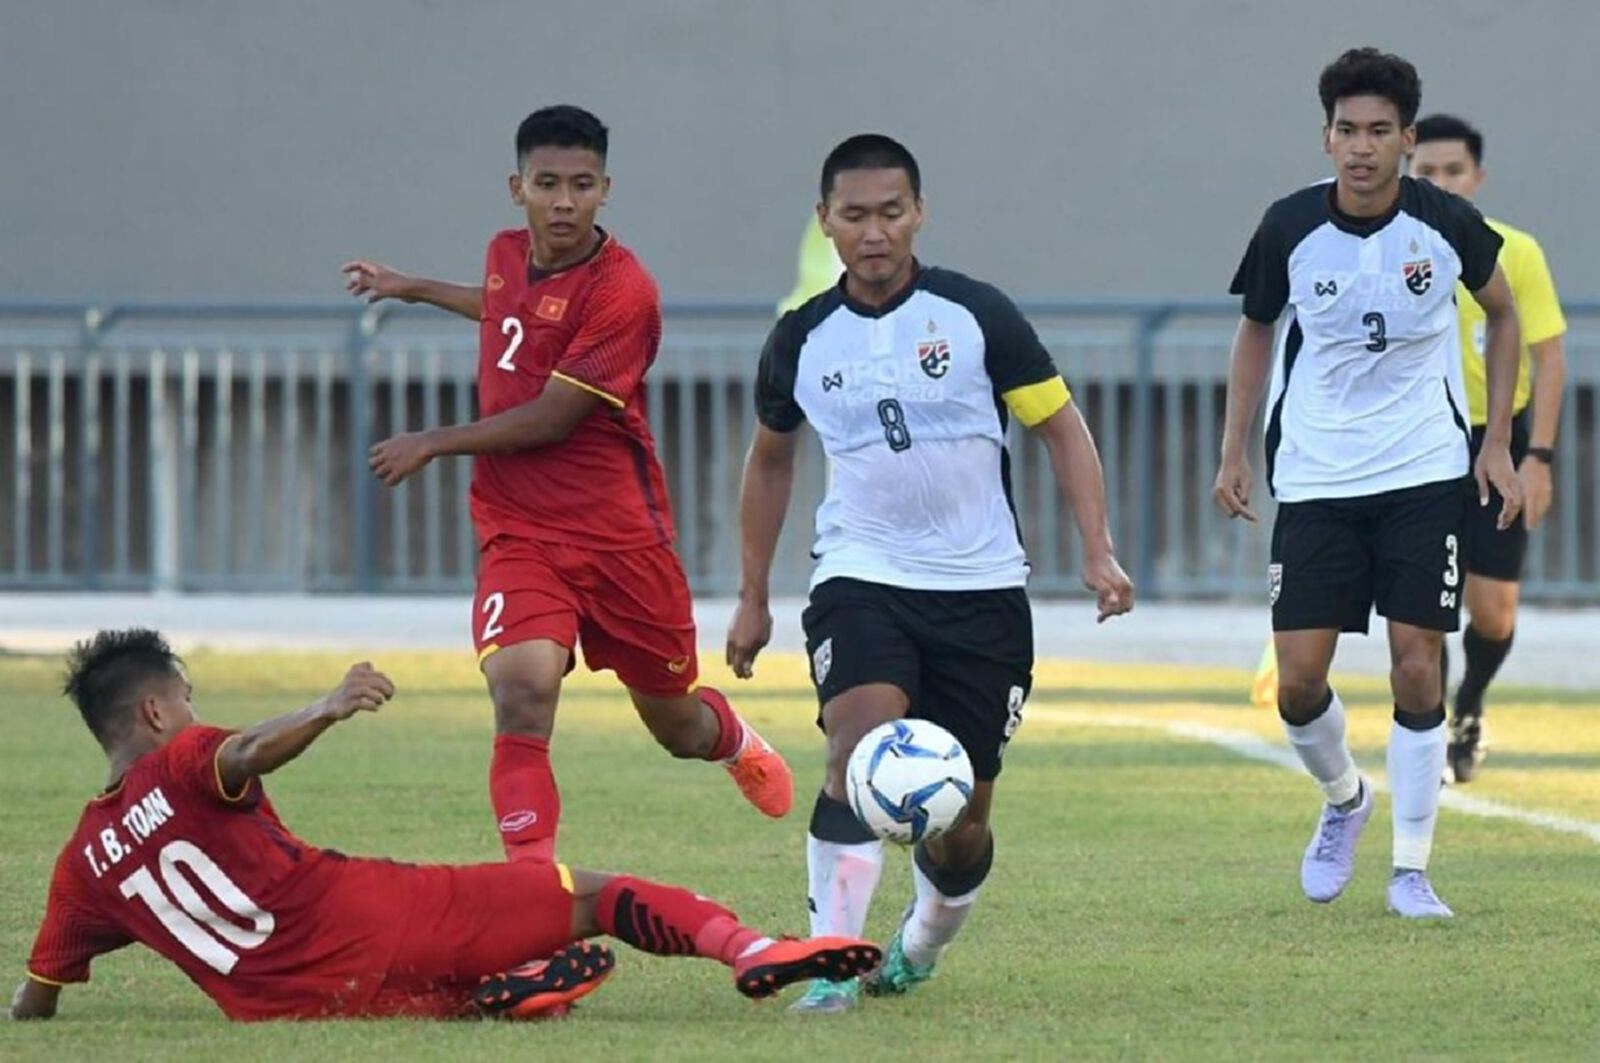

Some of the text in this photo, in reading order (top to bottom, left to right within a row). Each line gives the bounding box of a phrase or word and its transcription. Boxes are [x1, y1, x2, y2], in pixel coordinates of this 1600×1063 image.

[497, 316, 524, 372] 2
[1362, 311, 1387, 353] 3
[877, 398, 912, 453] 8
[1443, 534, 1459, 586] 3
[481, 592, 504, 641] 2
[1004, 685, 1024, 737] 8
[119, 839, 276, 976] 10
